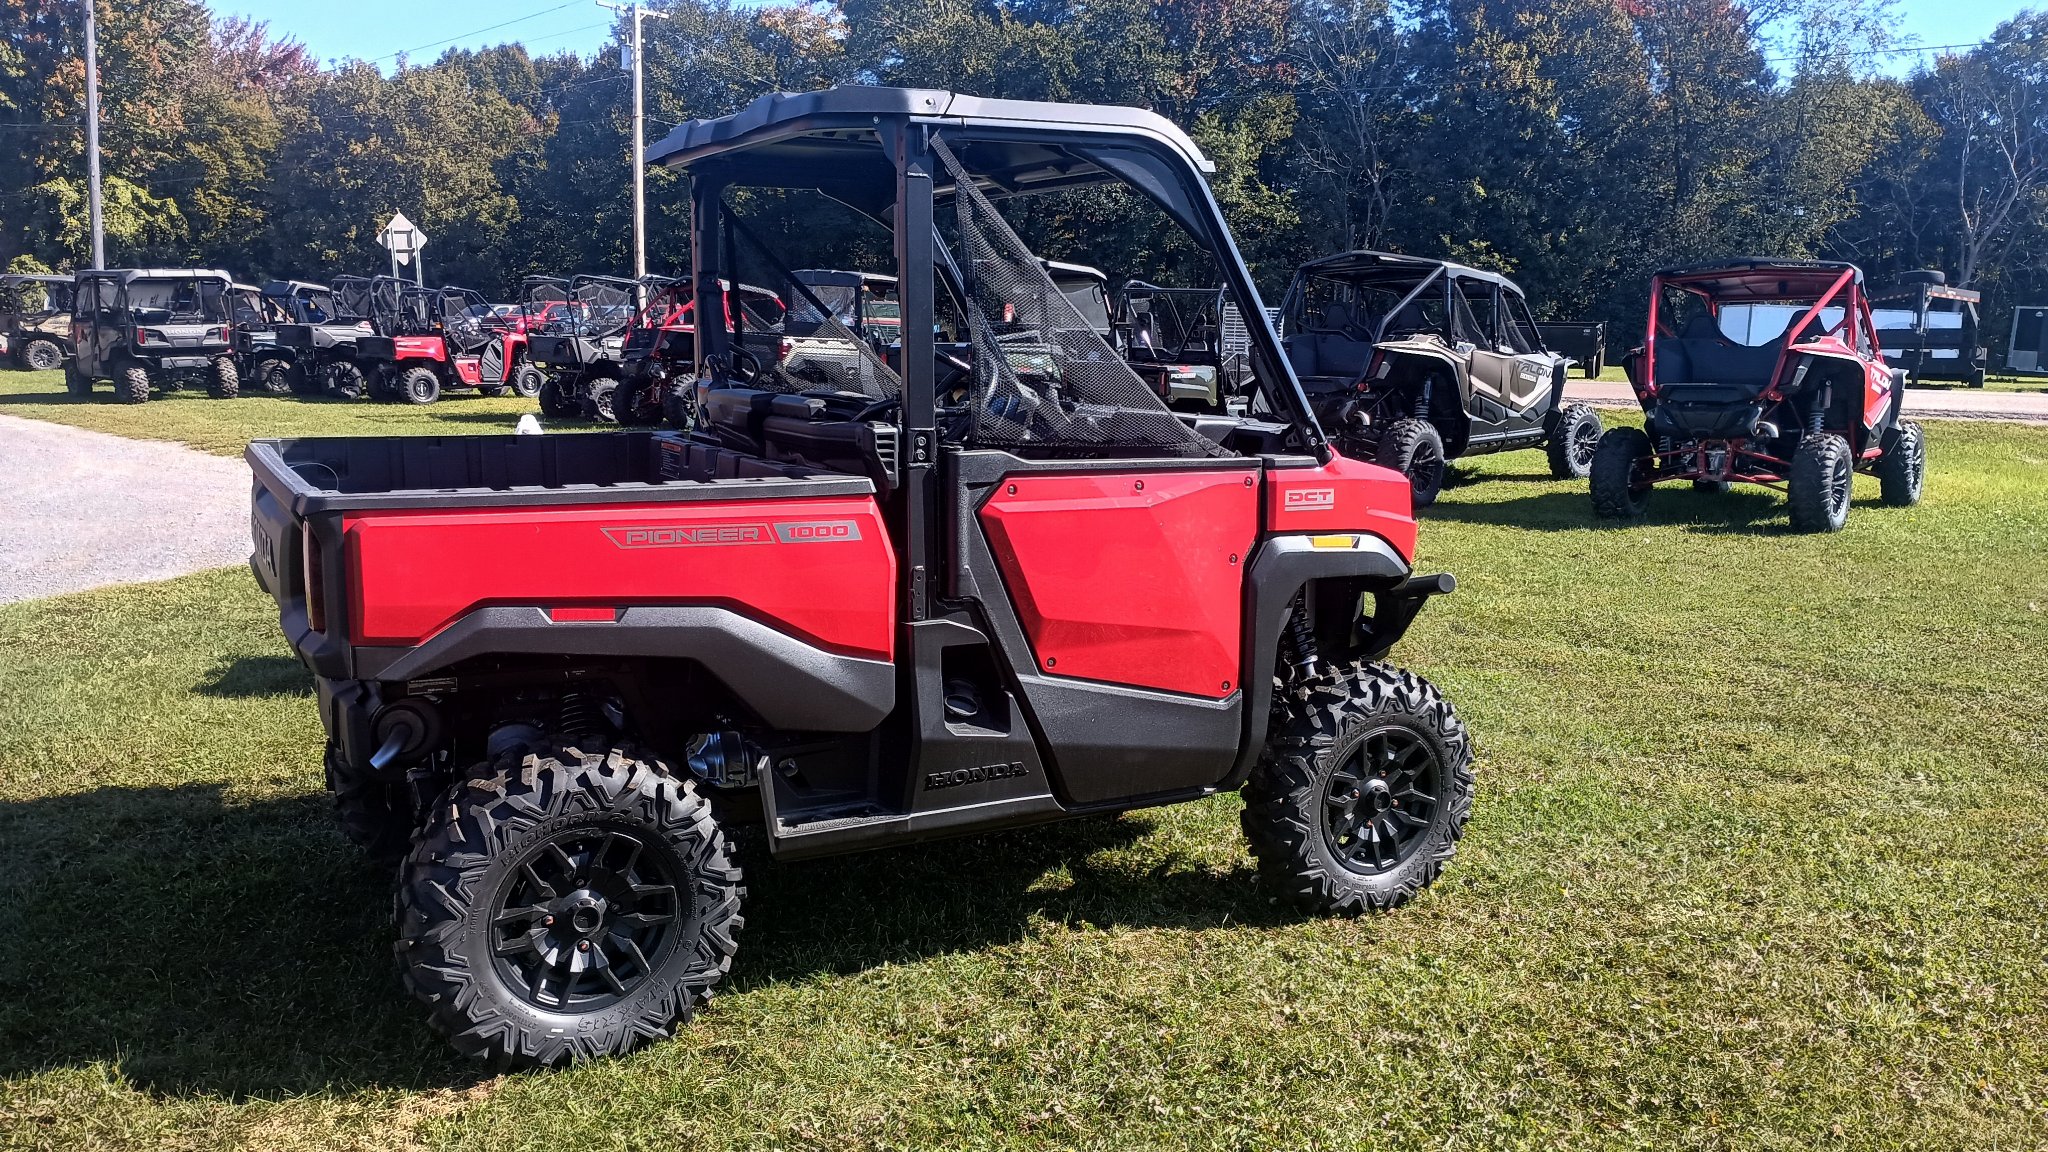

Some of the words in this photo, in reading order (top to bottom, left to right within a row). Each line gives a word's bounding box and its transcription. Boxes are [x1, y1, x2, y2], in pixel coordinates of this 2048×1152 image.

[1515, 360, 1552, 378] TALON
[1288, 492, 1332, 502] DCT
[626, 527, 760, 545] PIONEER
[788, 525, 848, 539] 1000
[924, 761, 1030, 791] HONDA
